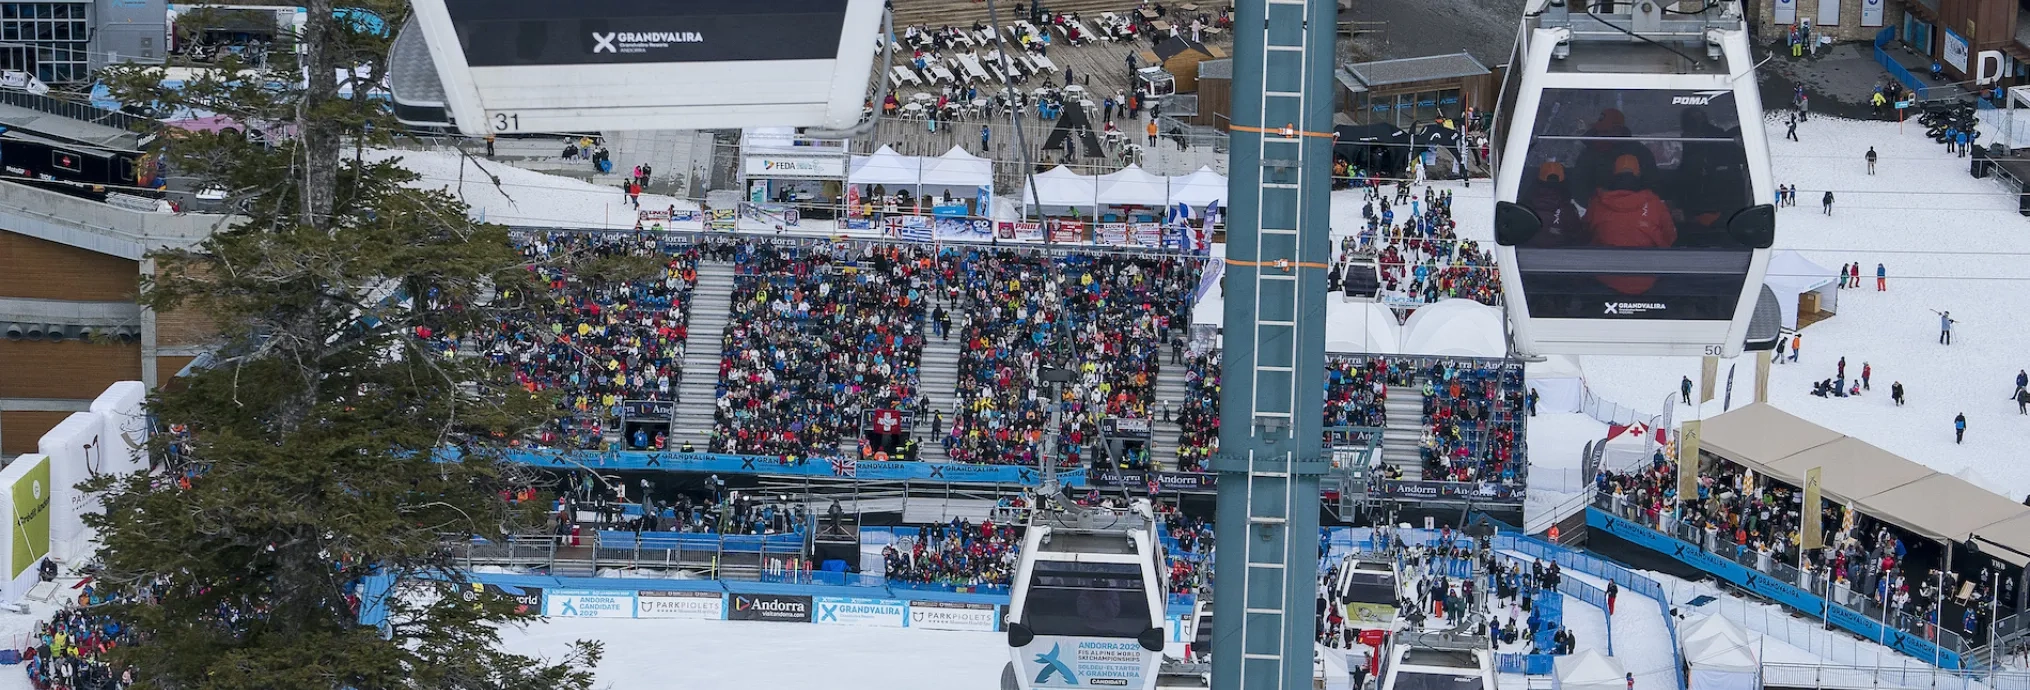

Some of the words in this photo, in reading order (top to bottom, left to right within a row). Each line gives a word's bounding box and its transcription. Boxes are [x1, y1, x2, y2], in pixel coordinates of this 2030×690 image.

[618, 32, 704, 42] GRANDVALIRA
[1671, 96, 1709, 105] POMA
[495, 113, 520, 131] 31
[776, 162, 796, 170] FEDA
[1618, 302, 1666, 310] GRANDVALIRA
[1705, 346, 1722, 356] 50
[1157, 474, 1197, 484] Andorra
[1396, 484, 1436, 494] Andorra
[656, 602, 719, 610] PARKPIOLETS
[751, 598, 805, 612] Andorra
[840, 604, 900, 615] GRANDVALIRA
[762, 610, 805, 618] visitandorra.com
[928, 612, 992, 620] PARKPIOLETS
[1078, 642, 1118, 650] ANDORRA
